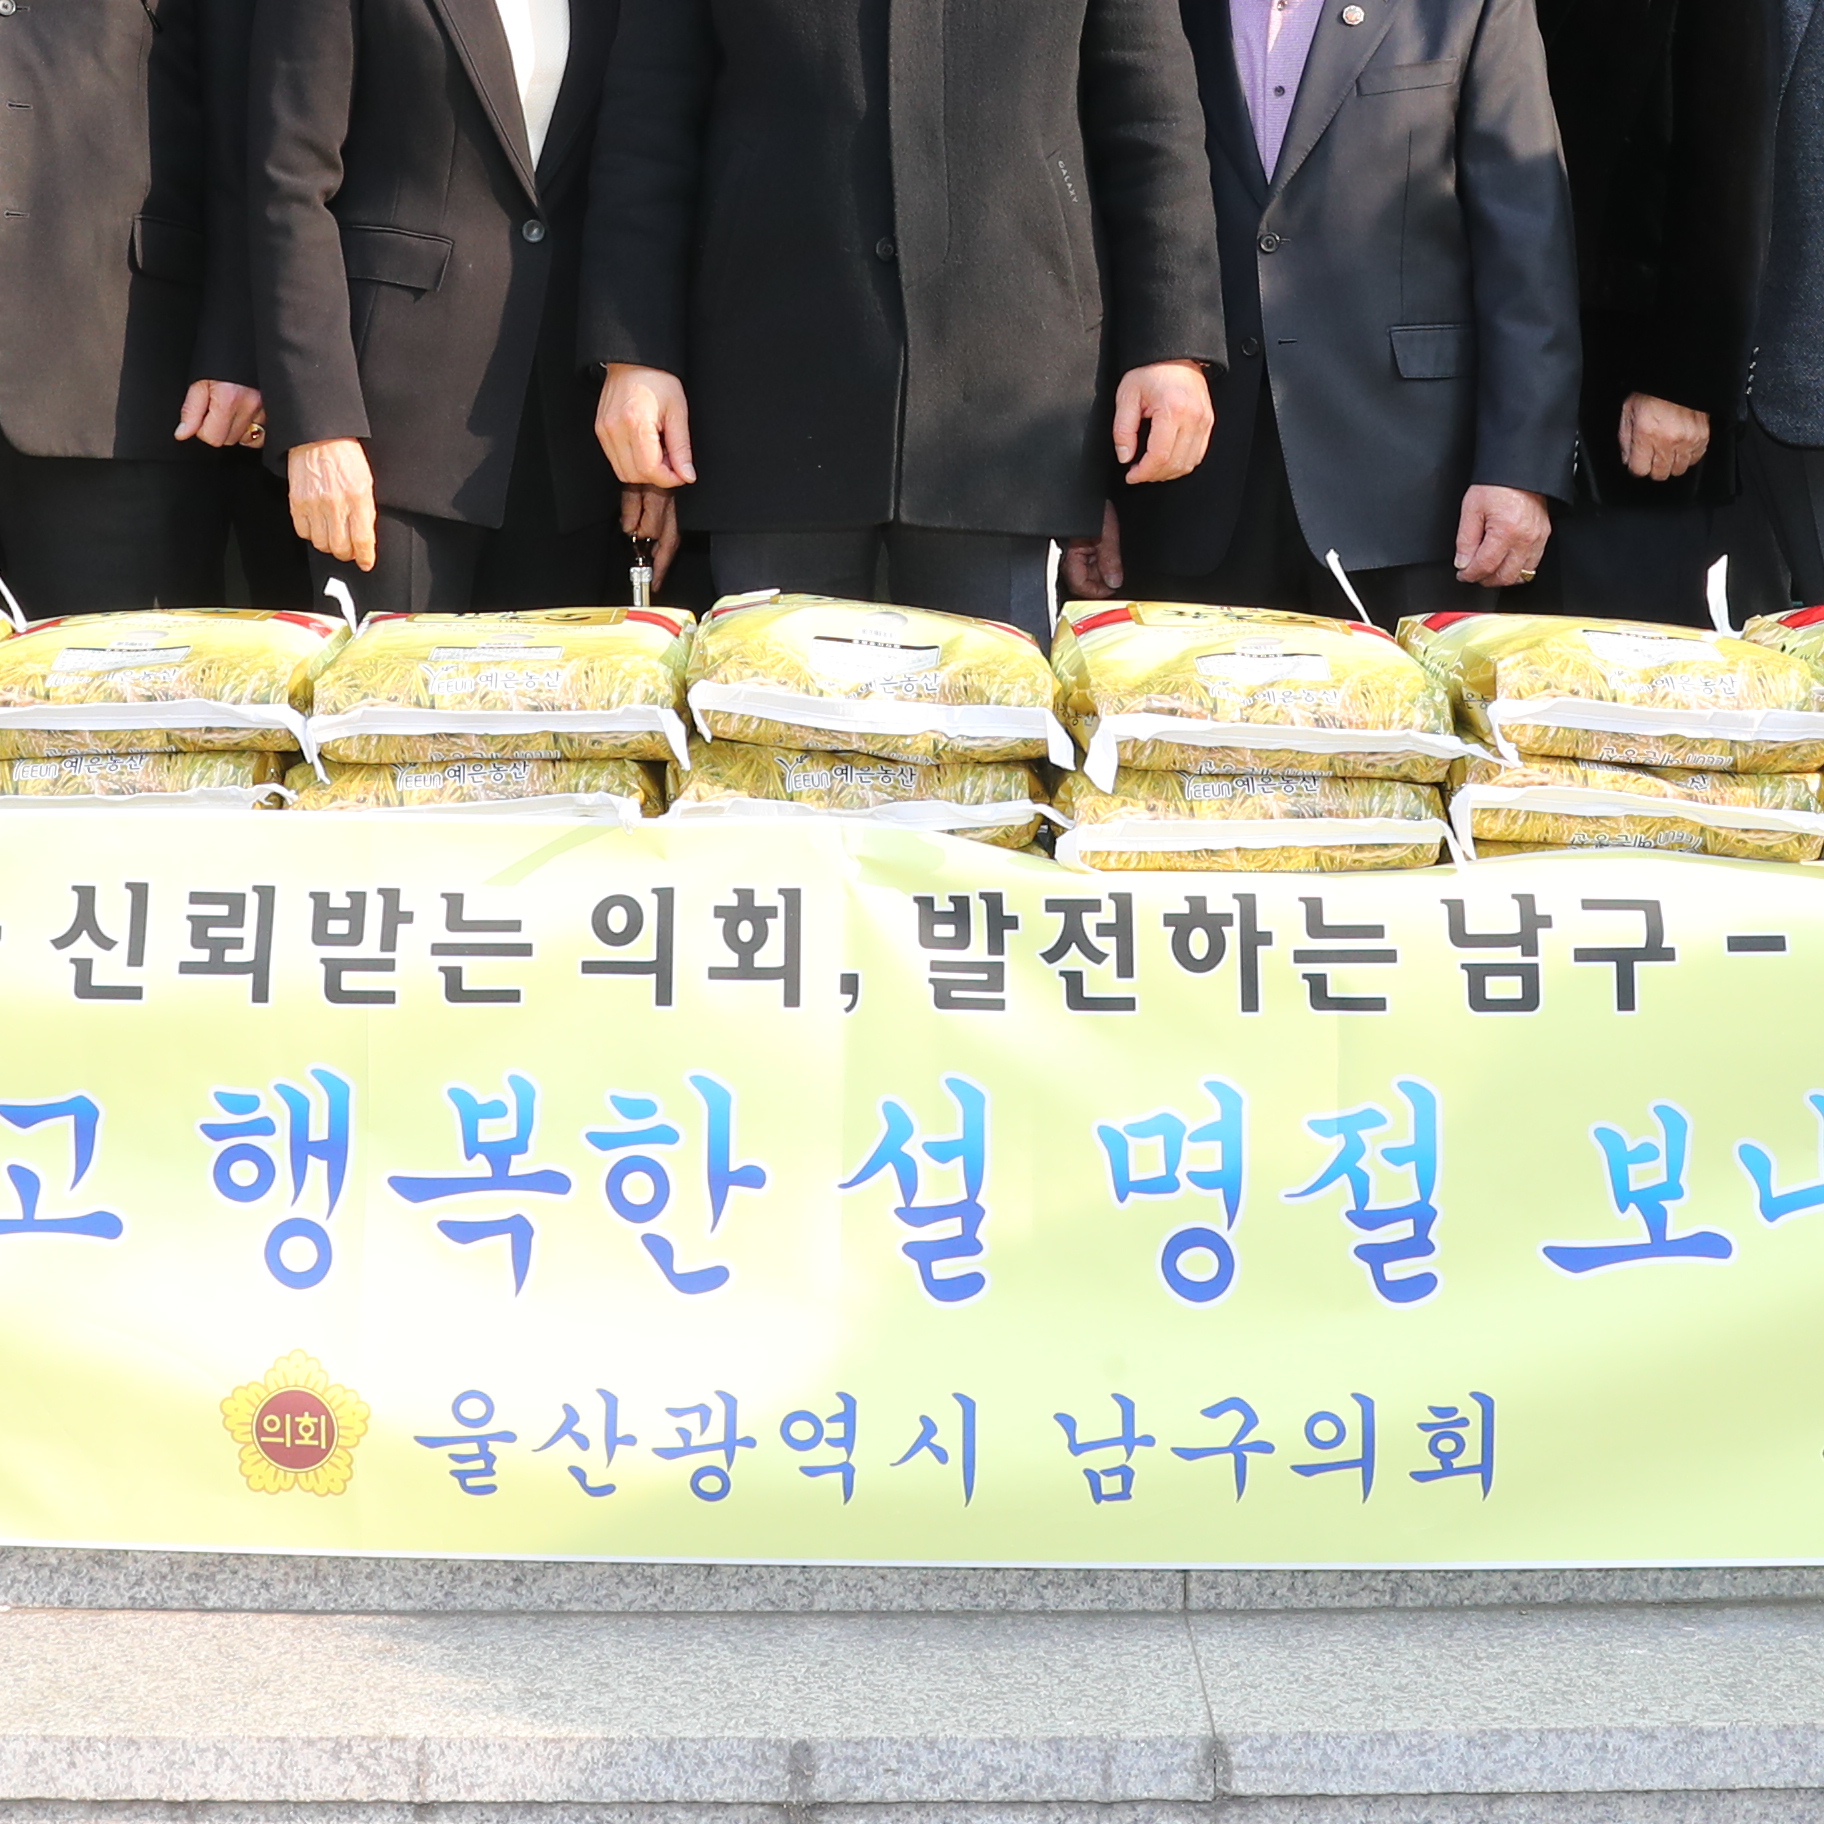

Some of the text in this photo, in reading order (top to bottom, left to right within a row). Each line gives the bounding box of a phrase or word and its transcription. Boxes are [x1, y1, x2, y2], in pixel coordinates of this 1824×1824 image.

[478, 669, 563, 690] 예은농산
[1653, 674, 1738, 696] 예은농산
[62, 754, 150, 776] 예은농산
[446, 761, 531, 787] 예은농산
[833, 764, 918, 788] 예은농산
[1233, 775, 1321, 795] 예은농산
[50, 880, 535, 1007] 신뢰받는
[580, 884, 860, 1014] 의회,
[911, 890, 1400, 1014] 발전하는
[1439, 891, 1678, 1014] 남구
[199, 1065, 768, 1299] 행복한
[836, 1073, 988, 1304] 설
[1093, 1075, 1442, 1305] 명절
[260, 1411, 327, 1449] 의회
[412, 1386, 1499, 1507] 울산광역시 남구의회
